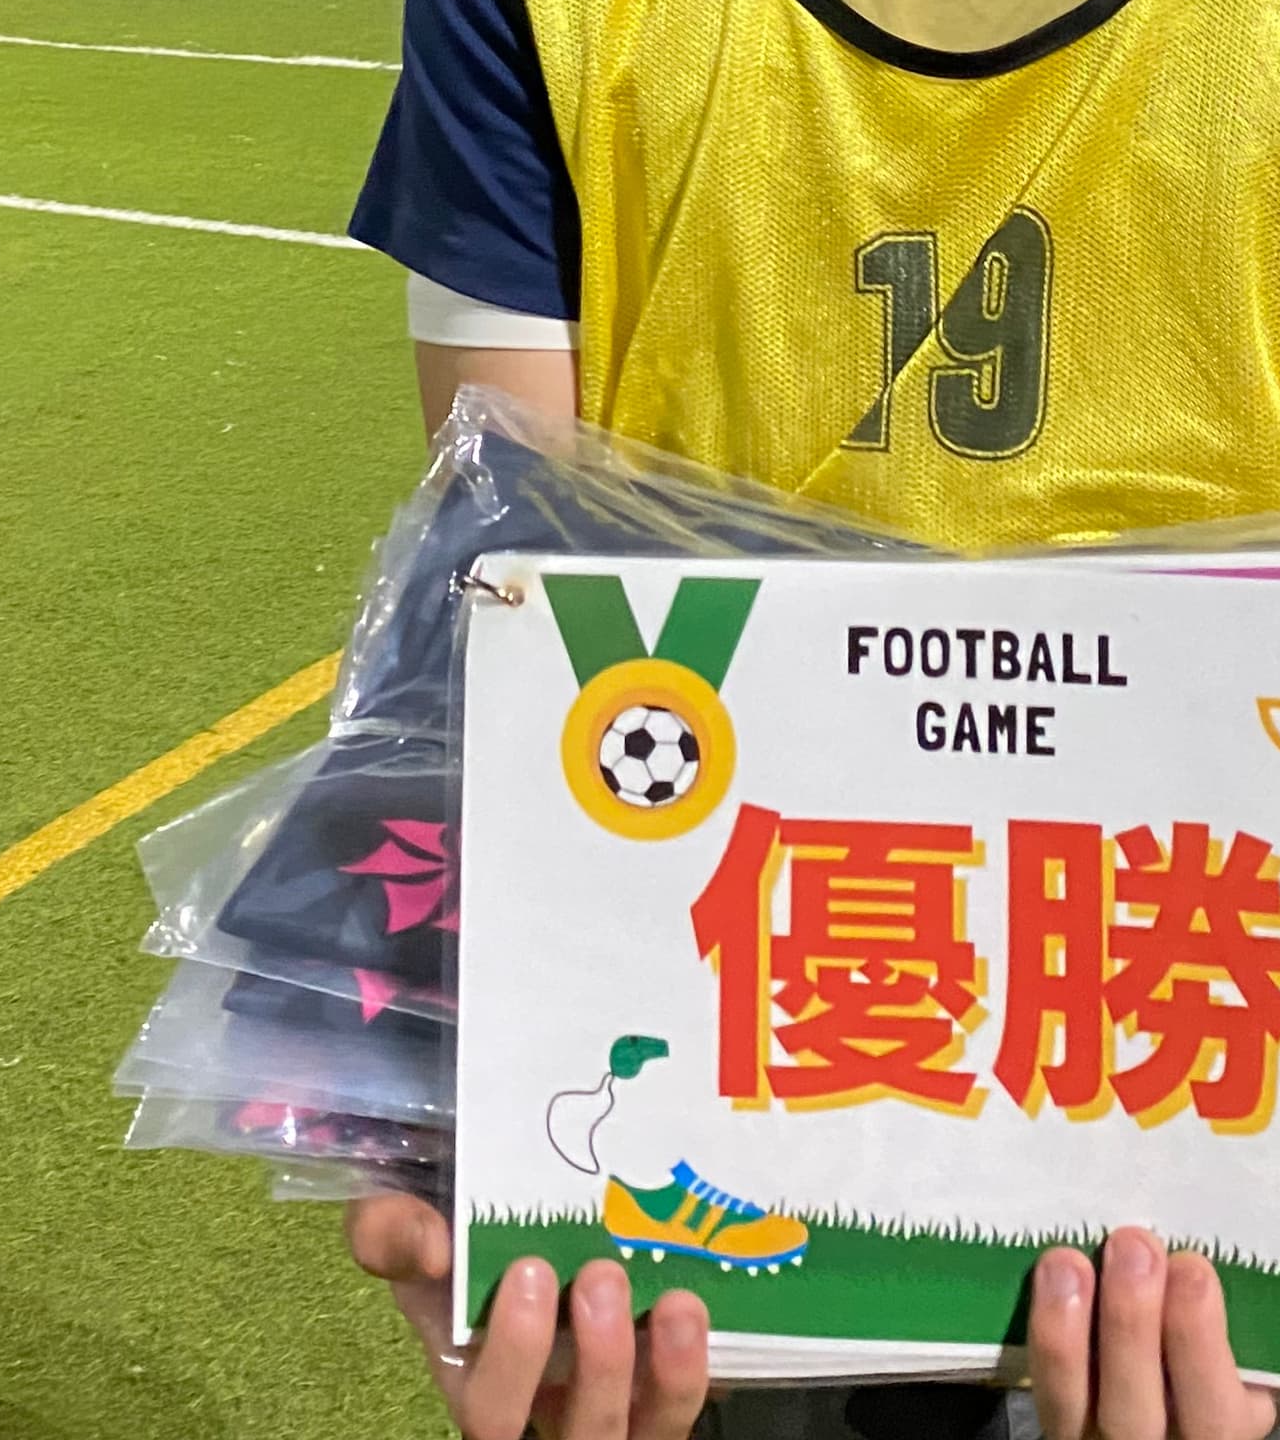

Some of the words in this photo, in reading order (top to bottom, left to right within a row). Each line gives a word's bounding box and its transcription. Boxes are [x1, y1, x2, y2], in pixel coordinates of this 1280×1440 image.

[838, 203, 1055, 459] 19
[846, 625, 1128, 686] FOOTBALL
[915, 701, 1056, 756] GAME
